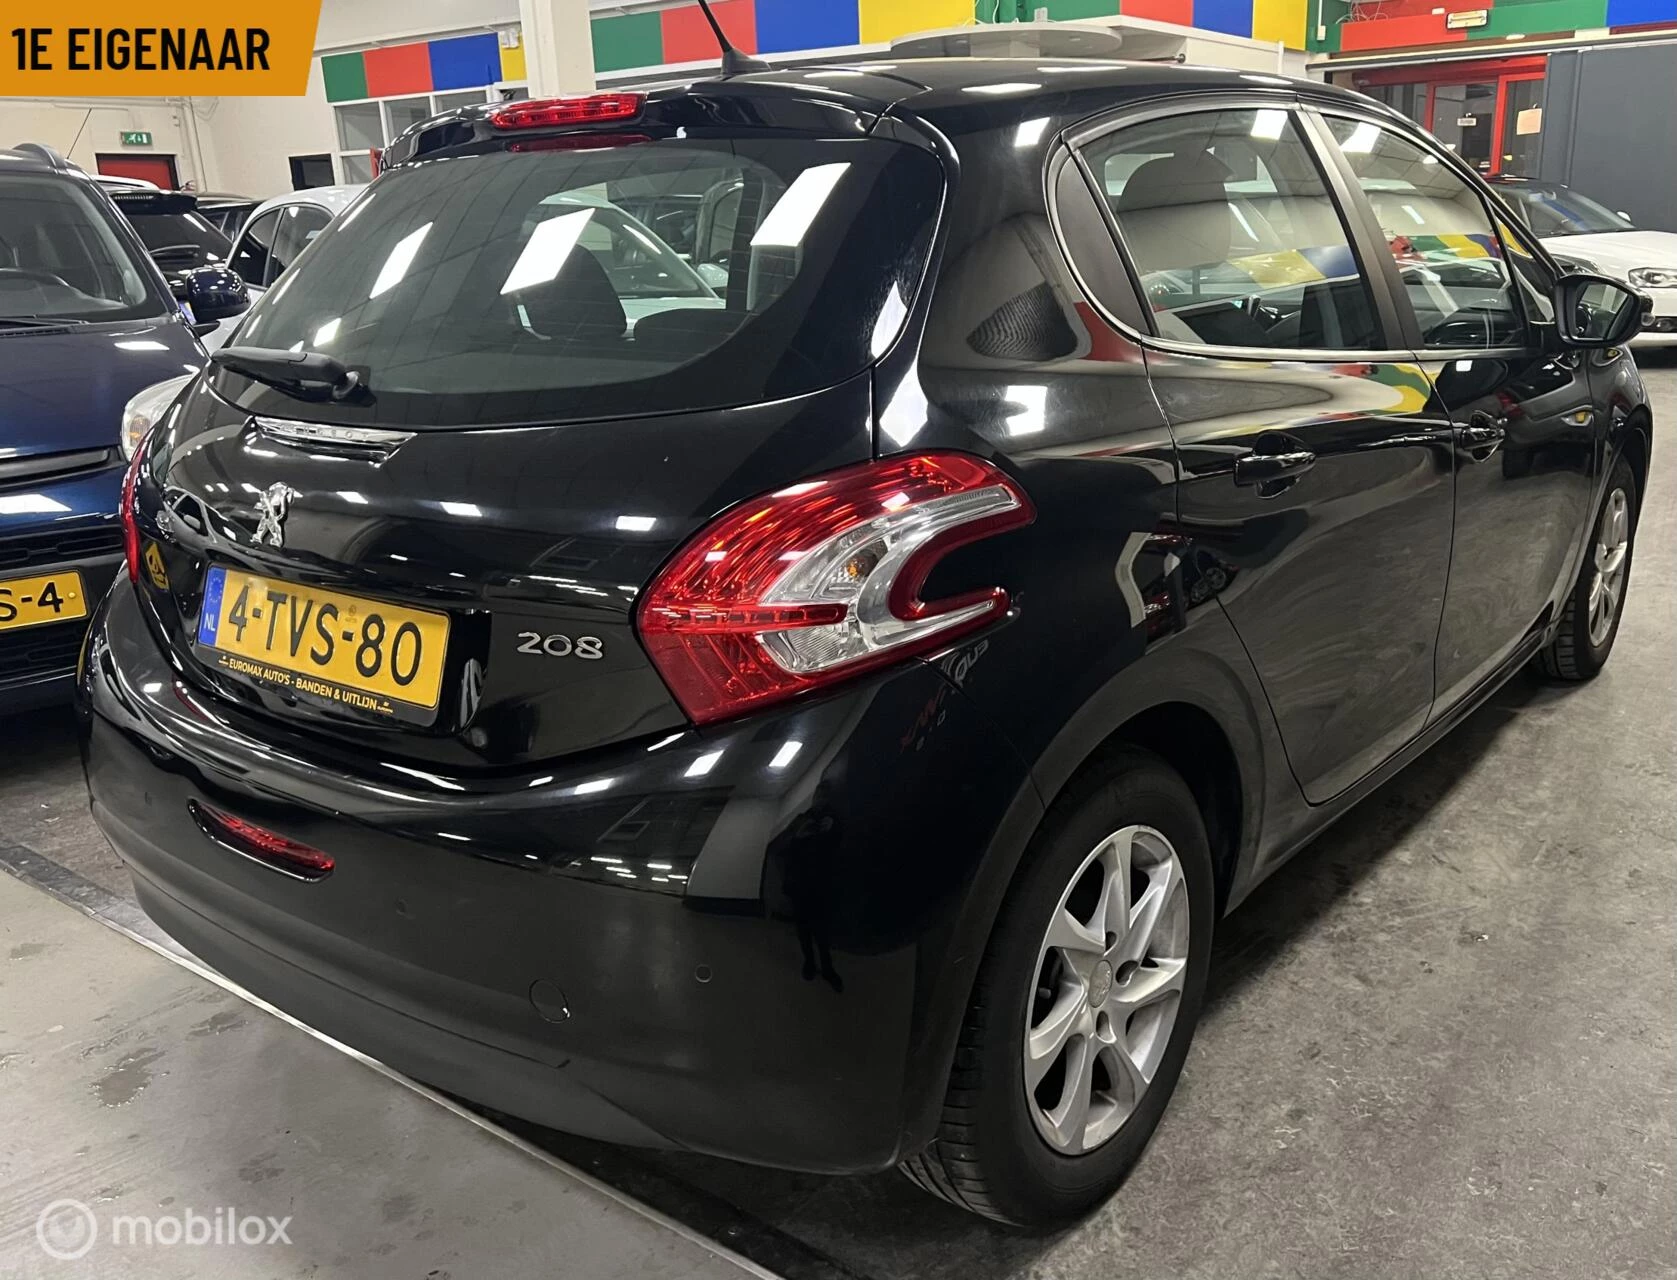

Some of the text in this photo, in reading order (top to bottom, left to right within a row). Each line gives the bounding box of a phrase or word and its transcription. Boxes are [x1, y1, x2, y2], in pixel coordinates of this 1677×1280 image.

[203, 613, 216, 631] NL
[228, 585, 422, 686] 4-TVS-80
[517, 631, 603, 659] 208
[229, 658, 263, 677] EUROMAX
[263, 669, 291, 685] AUTO'S
[295, 677, 333, 698] BANDEN
[333, 689, 340, 700] &
[342, 690, 378, 711] UITLIJN
